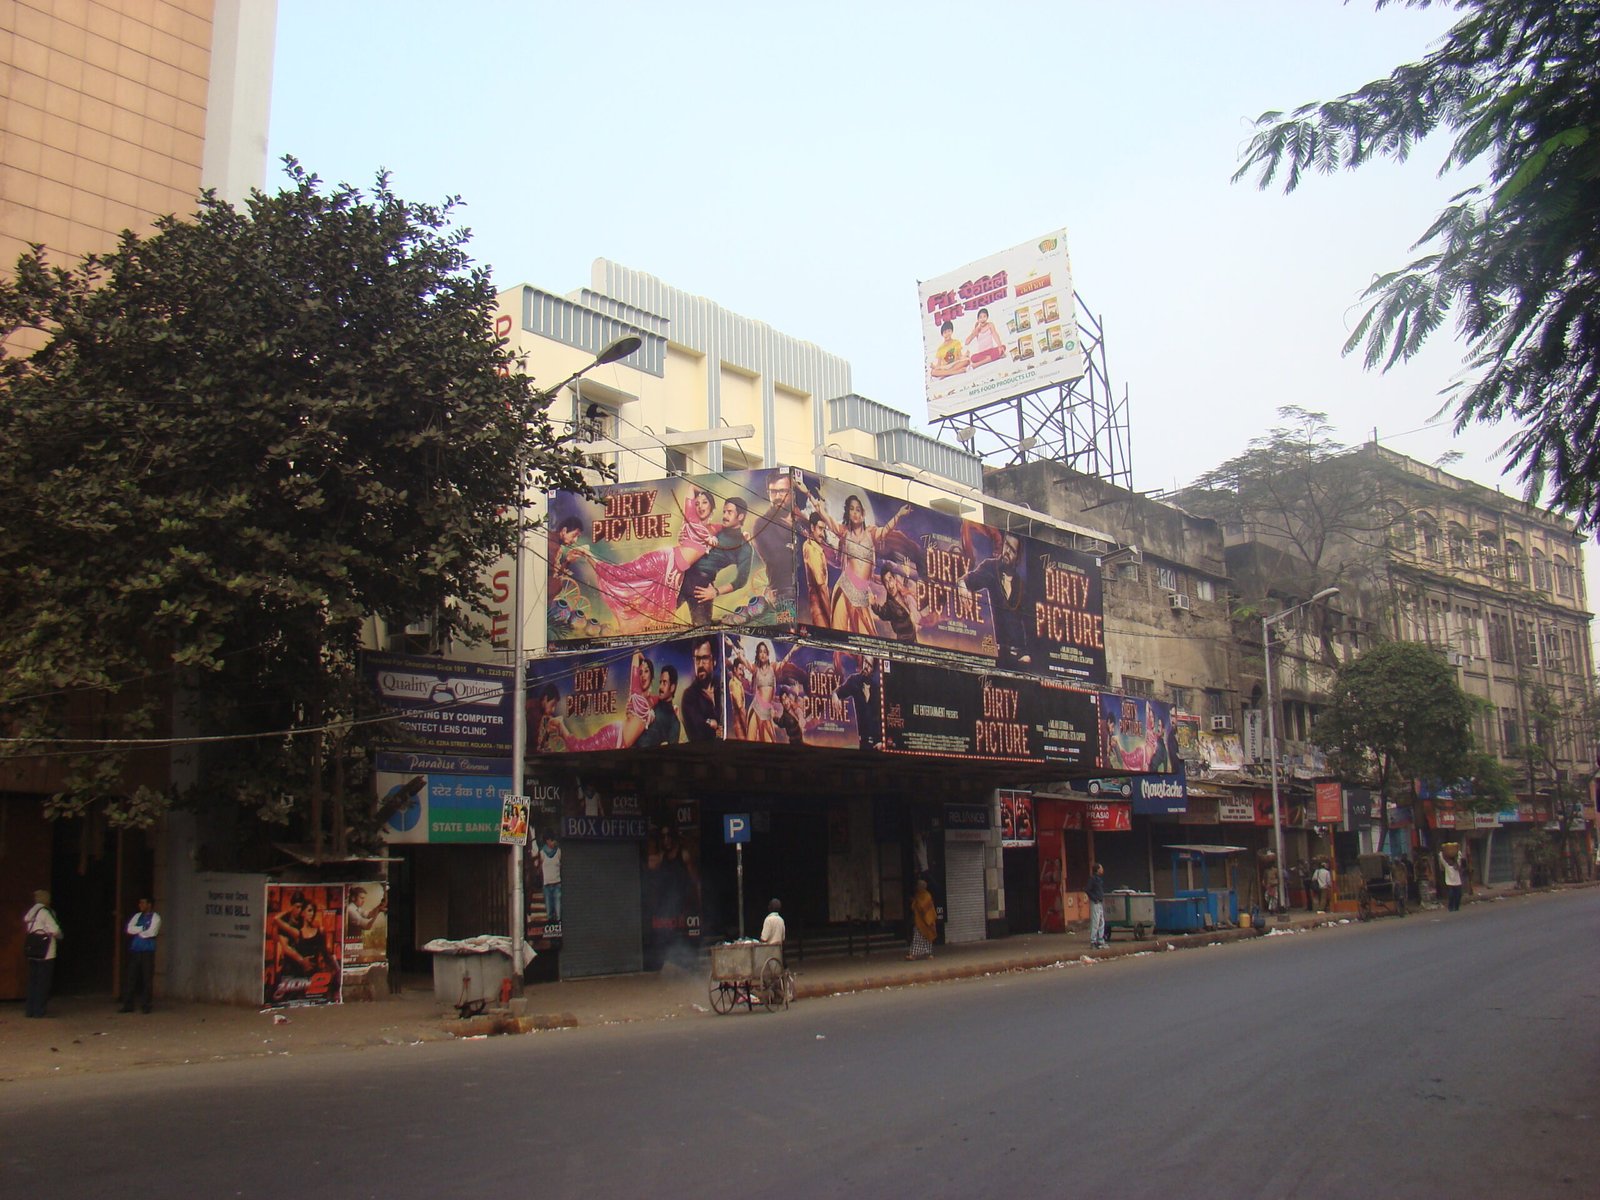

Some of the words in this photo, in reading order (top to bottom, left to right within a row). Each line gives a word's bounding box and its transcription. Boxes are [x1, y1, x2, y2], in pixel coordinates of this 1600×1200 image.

[981, 383, 995, 394] FOOD
[996, 374, 1025, 390] PRODUCTS
[605, 490, 658, 518] DIRTY
[592, 514, 672, 544] PICTURE
[920, 534, 938, 549] The
[926, 549, 971, 583] DIRTY
[1040, 553, 1057, 570] The
[1045, 568, 1089, 608] DIRTY
[916, 580, 985, 624] PICTURE
[1035, 602, 1104, 648] PICTURE
[383, 674, 429, 696] Quality
[454, 681, 501, 697] Opticians
[575, 666, 609, 692] DIRTY
[810, 672, 841, 694] DIRTY
[566, 690, 617, 717] PICTURE
[803, 696, 850, 722] PICTURE
[983, 687, 1018, 719] DIRTY
[1122, 701, 1137, 720] DIRTY
[442, 712, 454, 721] BY
[457, 713, 503, 724] COMPUTER
[400, 722, 437, 732] CONTECT
[440, 724, 460, 734] LENS
[462, 727, 487, 735] CLINIC
[976, 720, 1030, 755] PICTURE
[1120, 720, 1141, 736] PICTURE
[408, 755, 455, 770] Paradise
[458, 757, 490, 771] Cinema
[432, 783, 452, 797] स्टेट
[455, 783, 473, 797] बैंक
[476, 788, 482, 798] ए
[485, 785, 495, 798] टी
[534, 786, 560, 800] LUCK
[1141, 778, 1184, 799] Moustache
[613, 794, 638, 808] cozi
[432, 823, 462, 832] STATE
[465, 823, 491, 832] BANK
[568, 817, 598, 836] BOX
[601, 818, 645, 836] OFFICE
[730, 819, 744, 838] P
[205, 904, 222, 915] STICK
[225, 904, 233, 915] NO
[235, 904, 250, 916] BILL
[544, 921, 562, 933] cozi
[687, 915, 699, 927] on
[305, 972, 331, 993] 2
